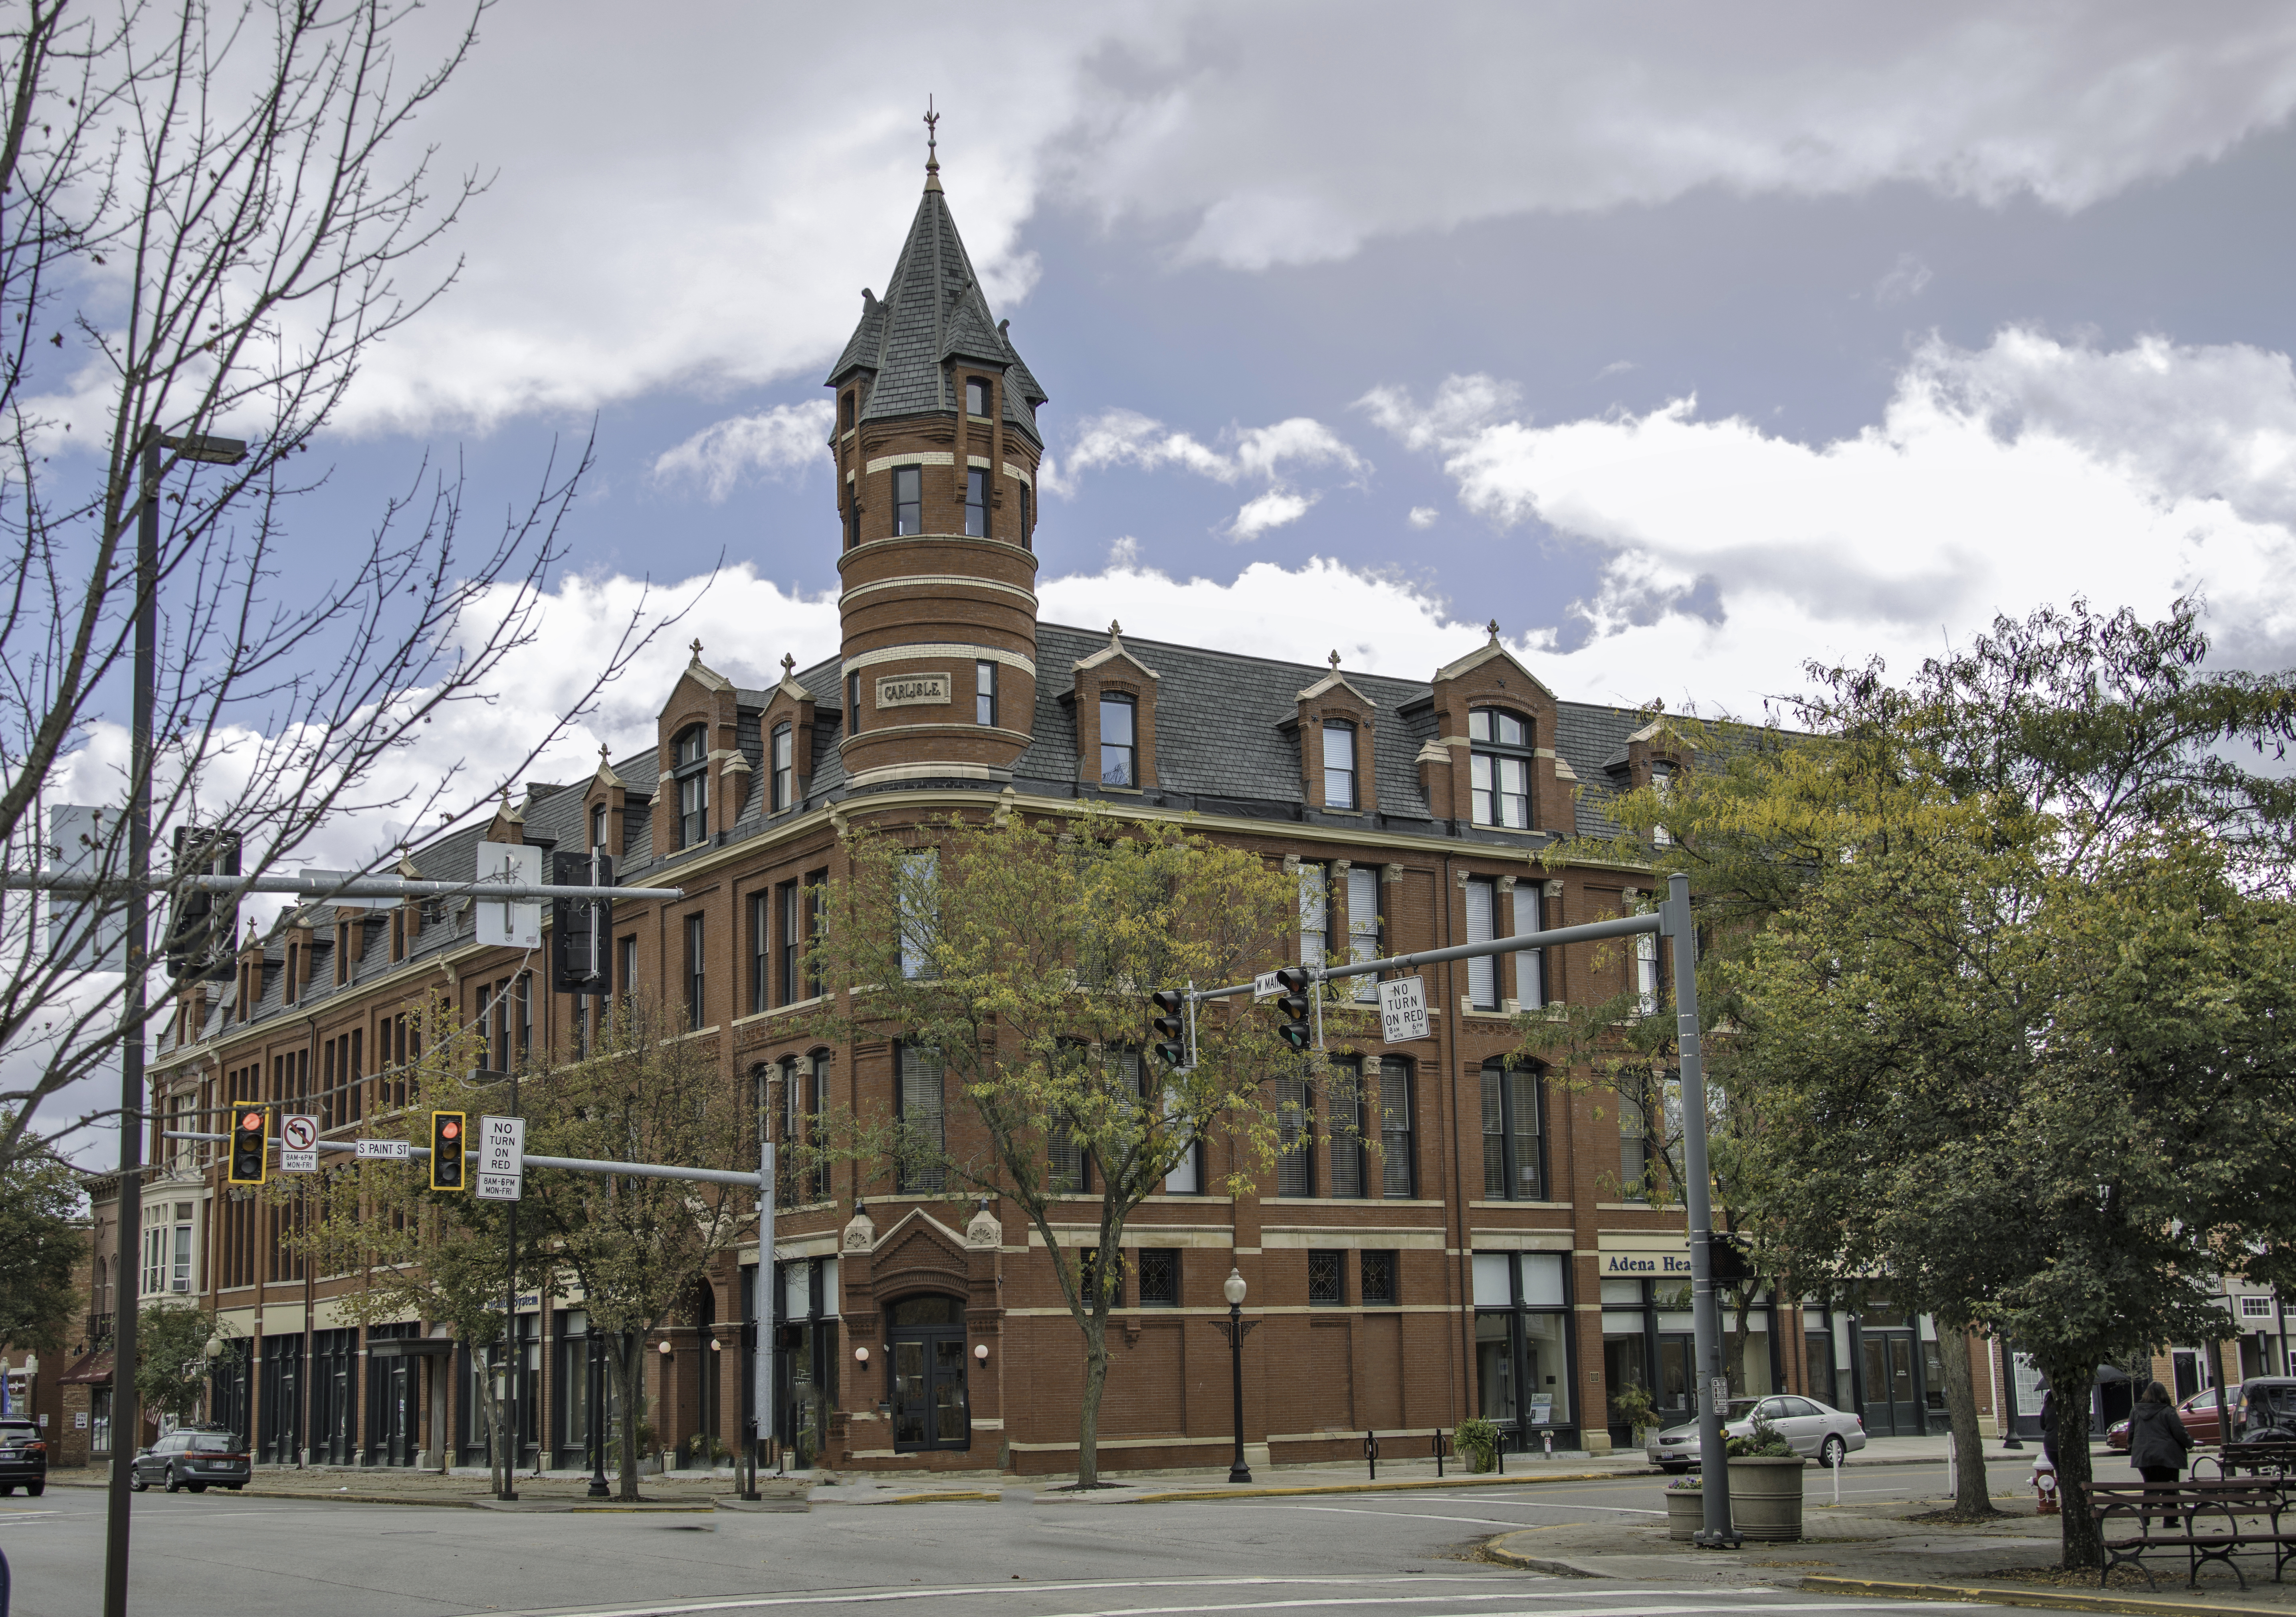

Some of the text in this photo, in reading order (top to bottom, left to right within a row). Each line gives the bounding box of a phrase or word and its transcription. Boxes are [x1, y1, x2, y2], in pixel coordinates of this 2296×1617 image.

[1257, 980, 1262, 992] W
[1393, 984, 1408, 996] NO
[1388, 996, 1418, 1010] TURN
[1386, 1009, 1423, 1027] ON RED
[495, 1123, 512, 1134] NO
[490, 1136, 515, 1146] TURN
[359, 1143, 408, 1155] S PAINT ST
[495, 1148, 508, 1158] ON
[491, 1160, 510, 1169] RED
[484, 1178, 515, 1186] 8AM-6PM
[485, 1186, 512, 1195] MON-FRI
[1608, 1256, 1691, 1271] Adena Hea
